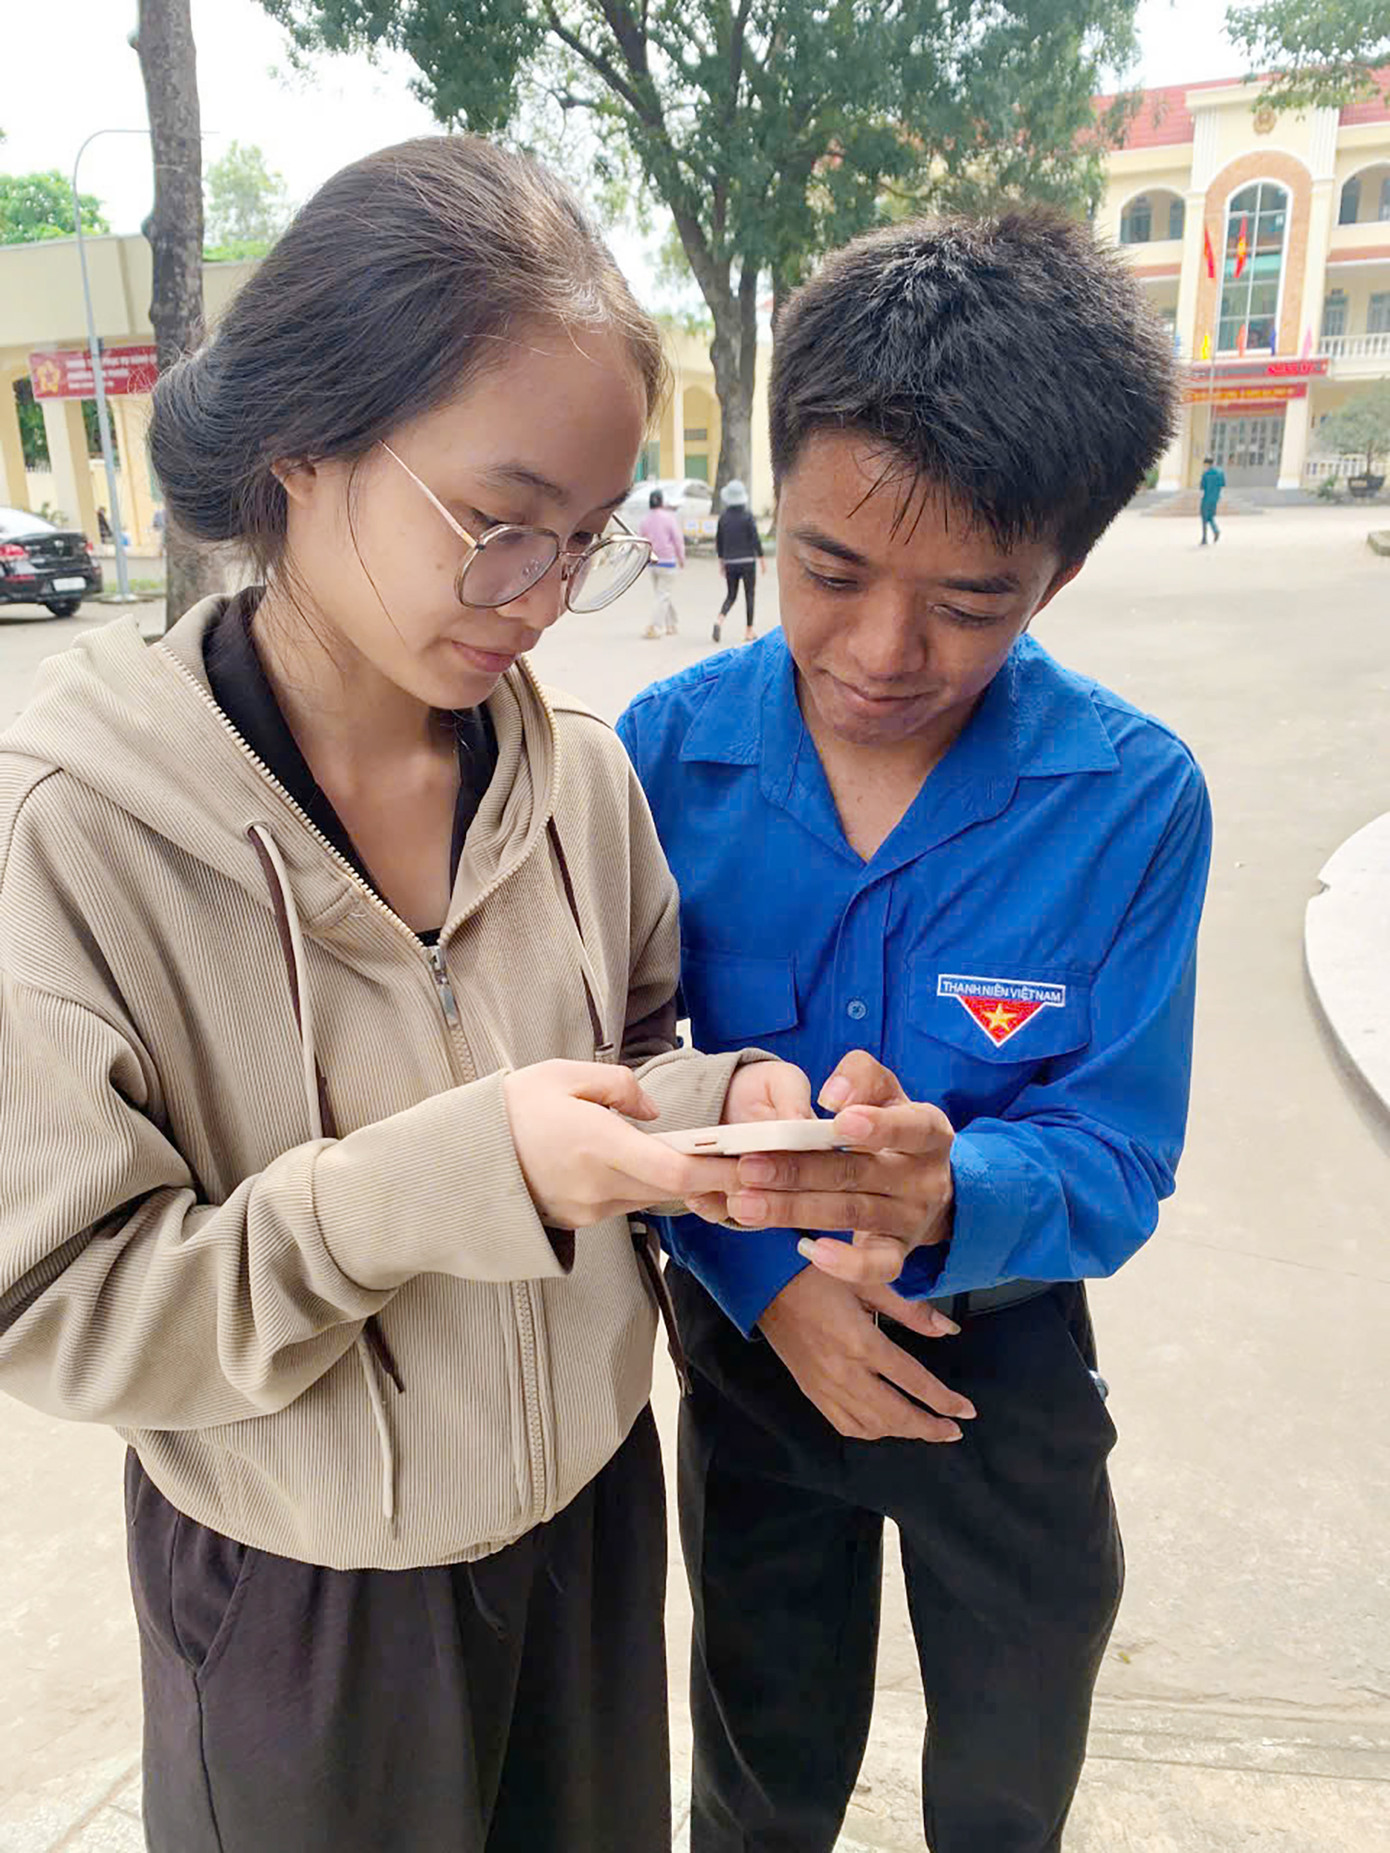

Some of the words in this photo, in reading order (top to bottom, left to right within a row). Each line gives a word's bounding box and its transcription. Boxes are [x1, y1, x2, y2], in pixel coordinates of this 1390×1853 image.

[943, 981, 981, 995] THANH
[982, 983, 1009, 997] NIÊN
[1010, 985, 1036, 1001] VIỆT
[1035, 990, 1061, 1002] NAM
